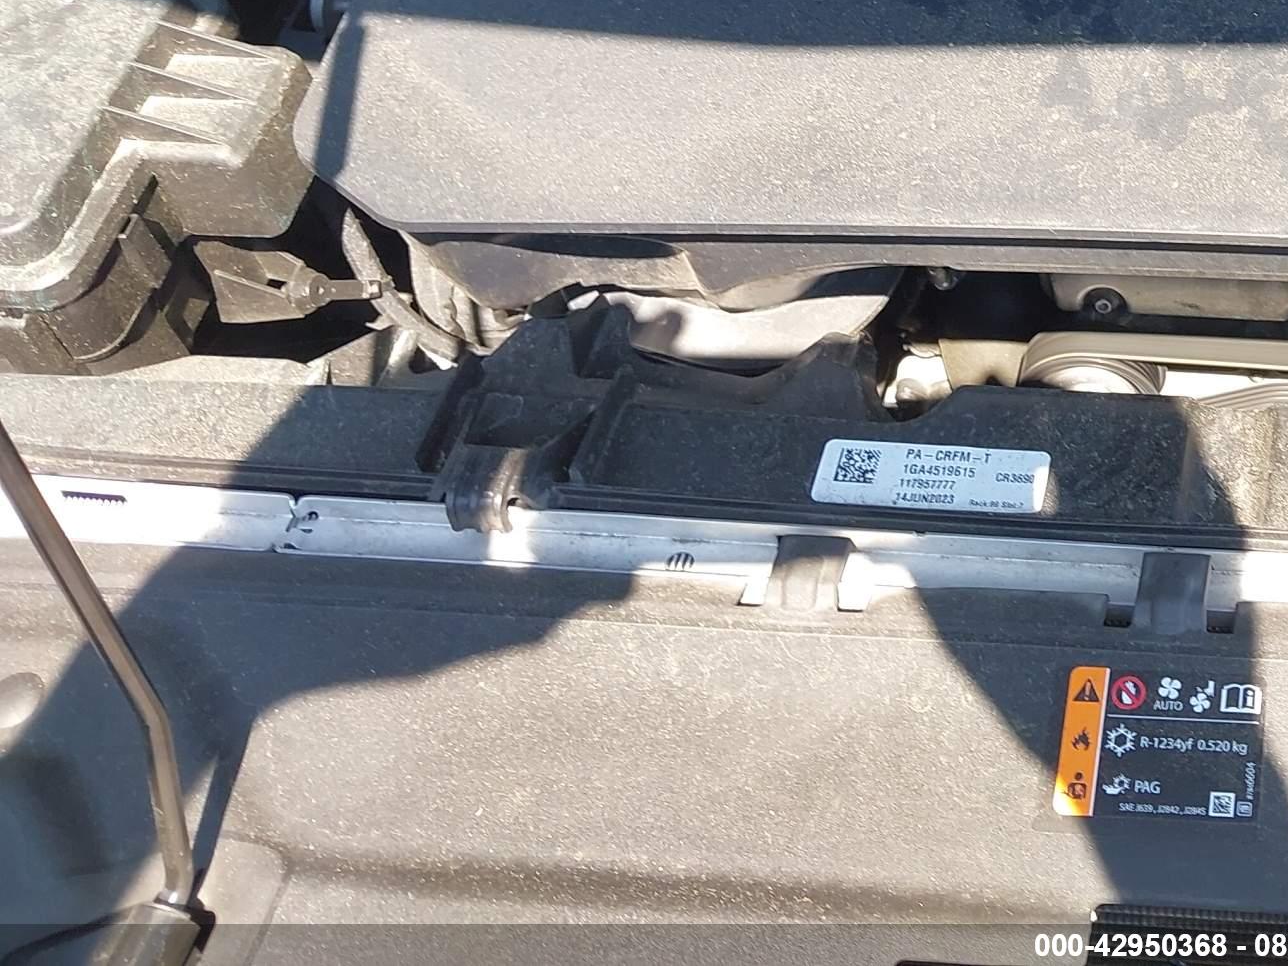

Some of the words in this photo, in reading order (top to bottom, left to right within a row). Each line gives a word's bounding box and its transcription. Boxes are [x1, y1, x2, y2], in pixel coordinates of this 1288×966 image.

[896, 492, 955, 504] 14JUN2023
[1153, 700, 1183, 711] AUTO
[1140, 736, 1194, 752] R-1234yf
[1197, 739, 1231, 752] 0.520
[1233, 741, 1248, 755] kg
[1134, 780, 1161, 794] PAG
